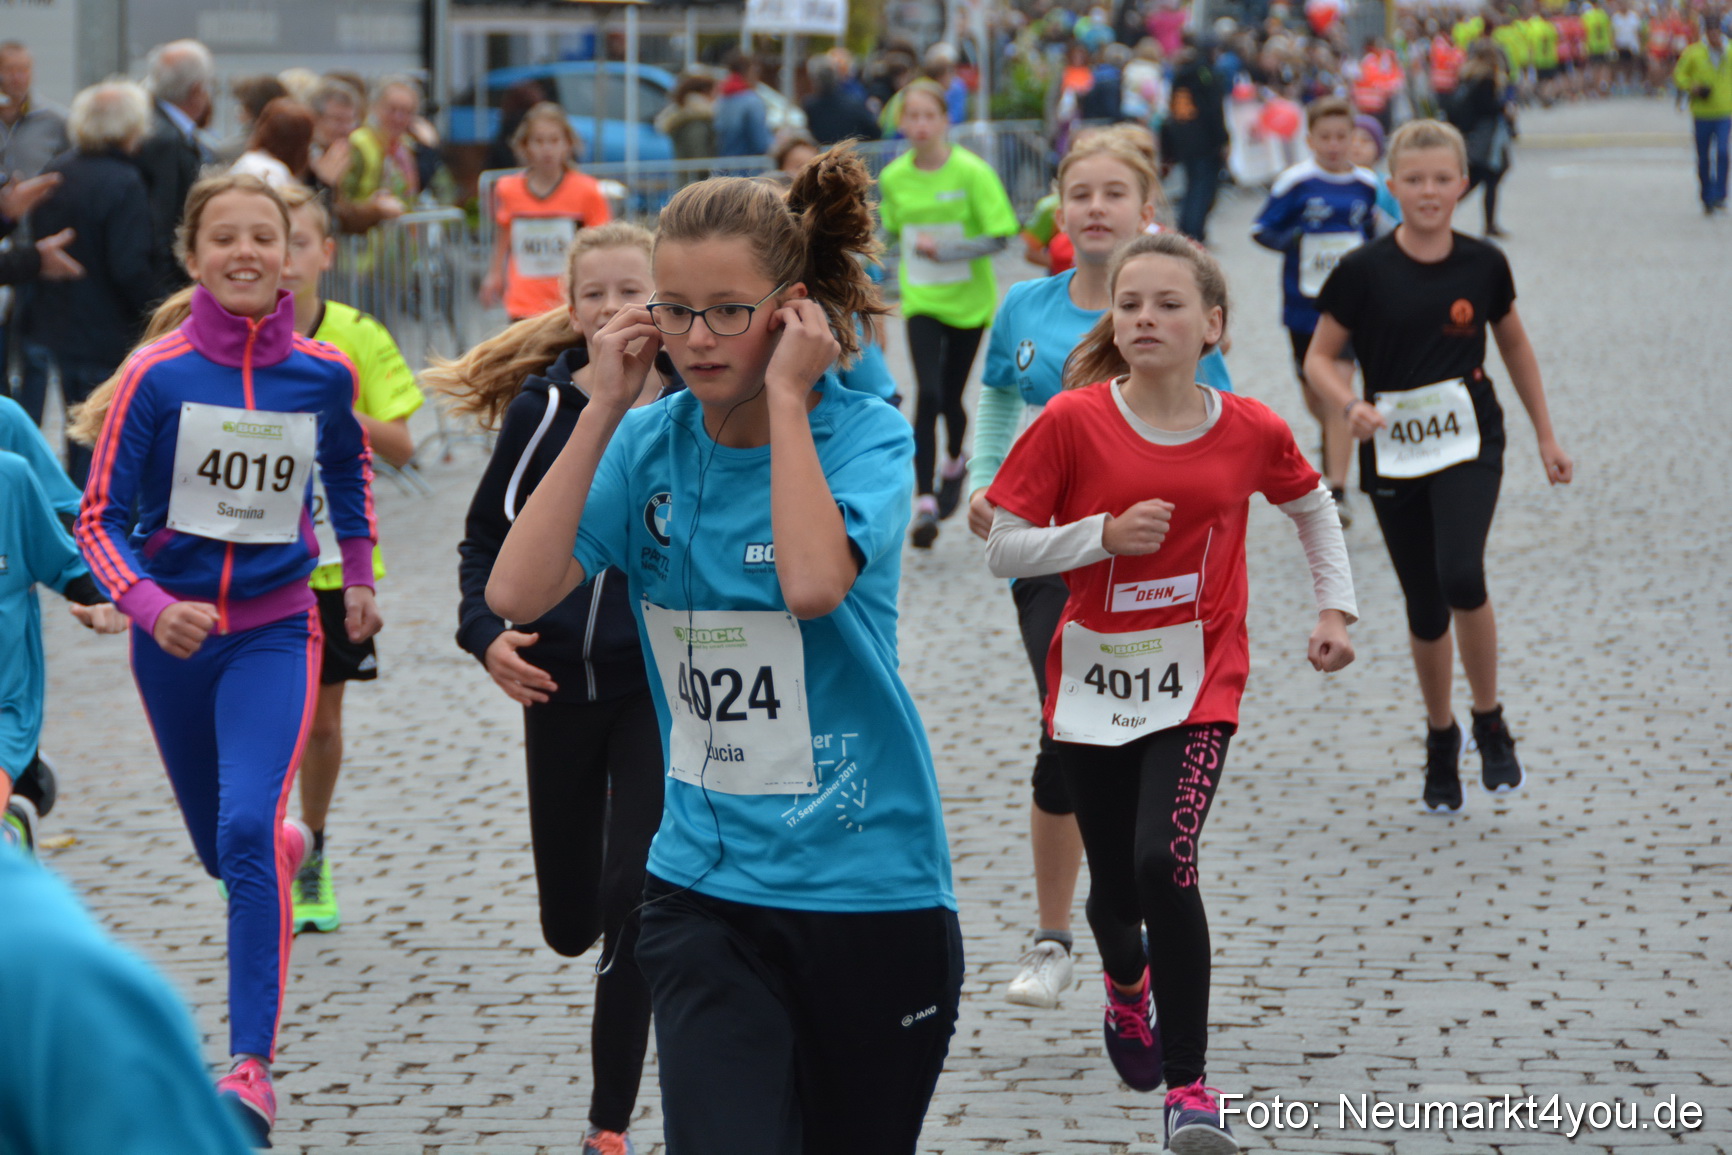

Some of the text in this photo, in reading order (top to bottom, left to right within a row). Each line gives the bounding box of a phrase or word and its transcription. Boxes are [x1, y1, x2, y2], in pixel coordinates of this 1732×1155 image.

[237, 422, 283, 437] BOCK
[1391, 411, 1460, 444] 4044
[197, 449, 295, 492] 4019
[217, 501, 265, 520] Samina
[1135, 585, 1175, 602] DEHN
[685, 626, 747, 643] BOCK
[1114, 637, 1163, 655] BOCK
[1084, 662, 1183, 702] 4014
[678, 661, 781, 722] 4024
[1111, 712, 1147, 729] Katja
[812, 733, 833, 749] er
[704, 739, 745, 762] Lucia
[786, 762, 858, 828] 17. September 2017
[914, 1005, 937, 1021] JAKO
